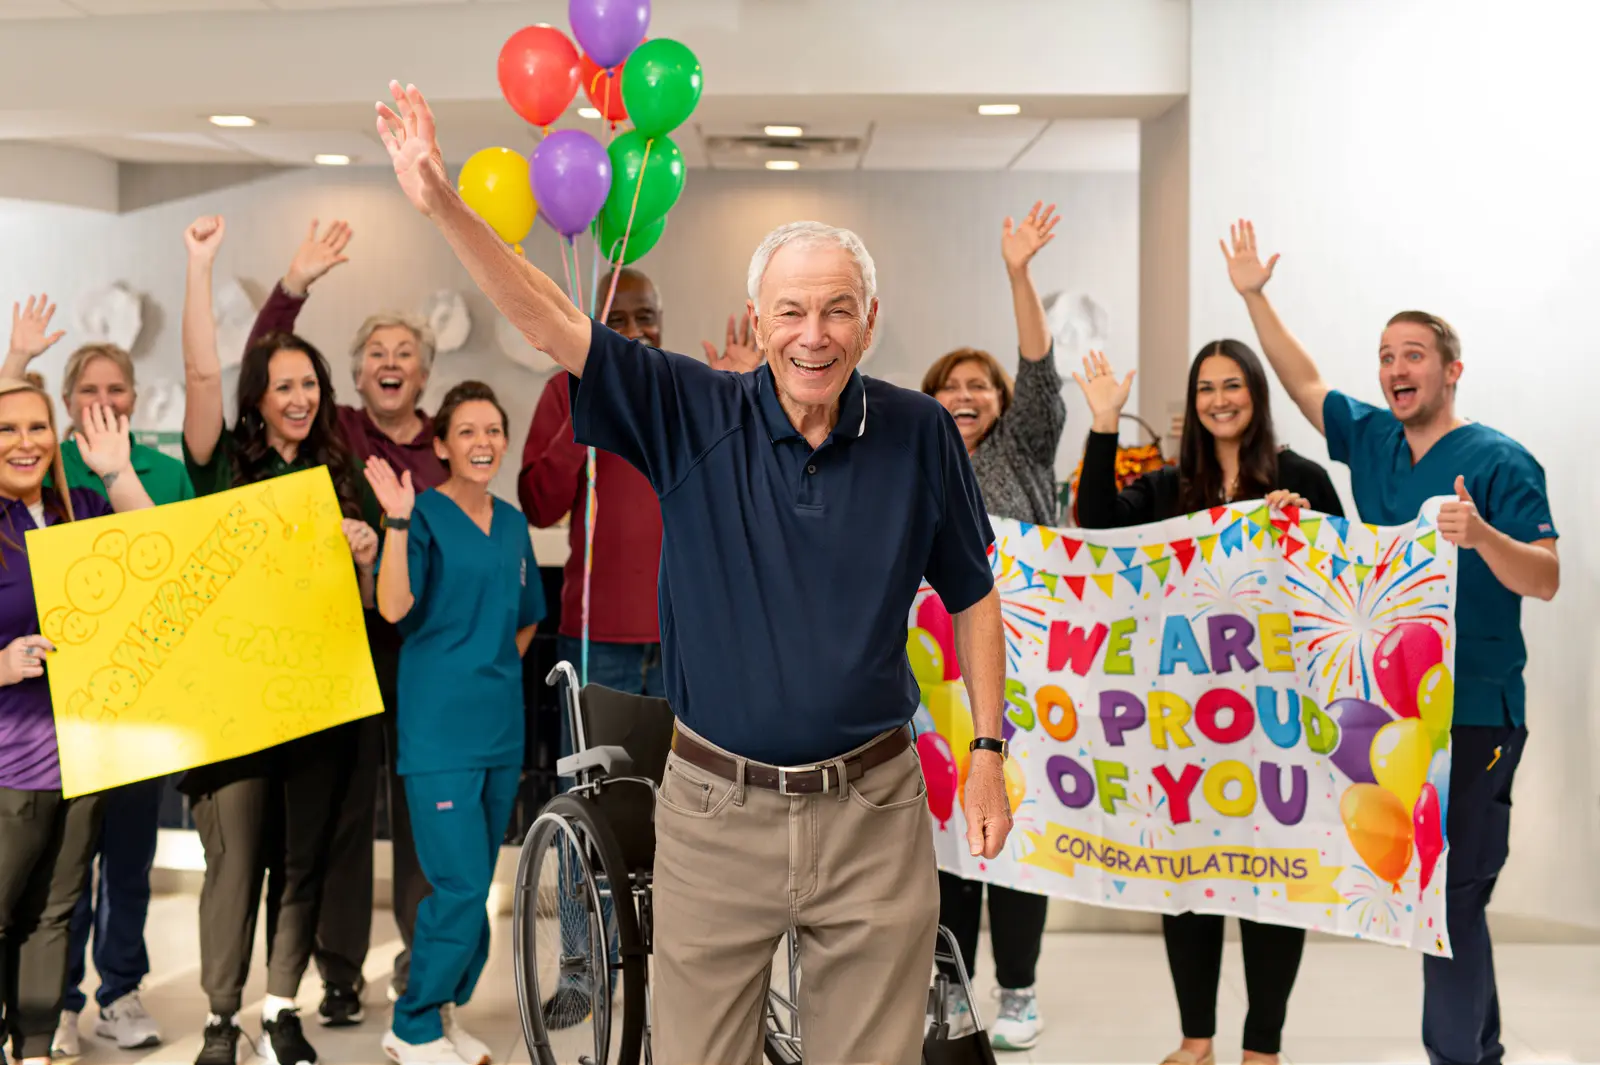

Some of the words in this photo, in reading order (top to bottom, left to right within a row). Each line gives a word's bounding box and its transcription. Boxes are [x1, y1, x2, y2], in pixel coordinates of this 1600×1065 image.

[214, 616, 325, 673] TAKE
[1047, 616, 1138, 677] WE
[1158, 613, 1296, 675] ARE
[1005, 678, 1078, 742] SO
[1099, 685, 1339, 755] PROUD
[1046, 754, 1129, 815] OF
[1152, 760, 1308, 826] YOU
[1055, 834, 1308, 879] CONGRATULATIONS
